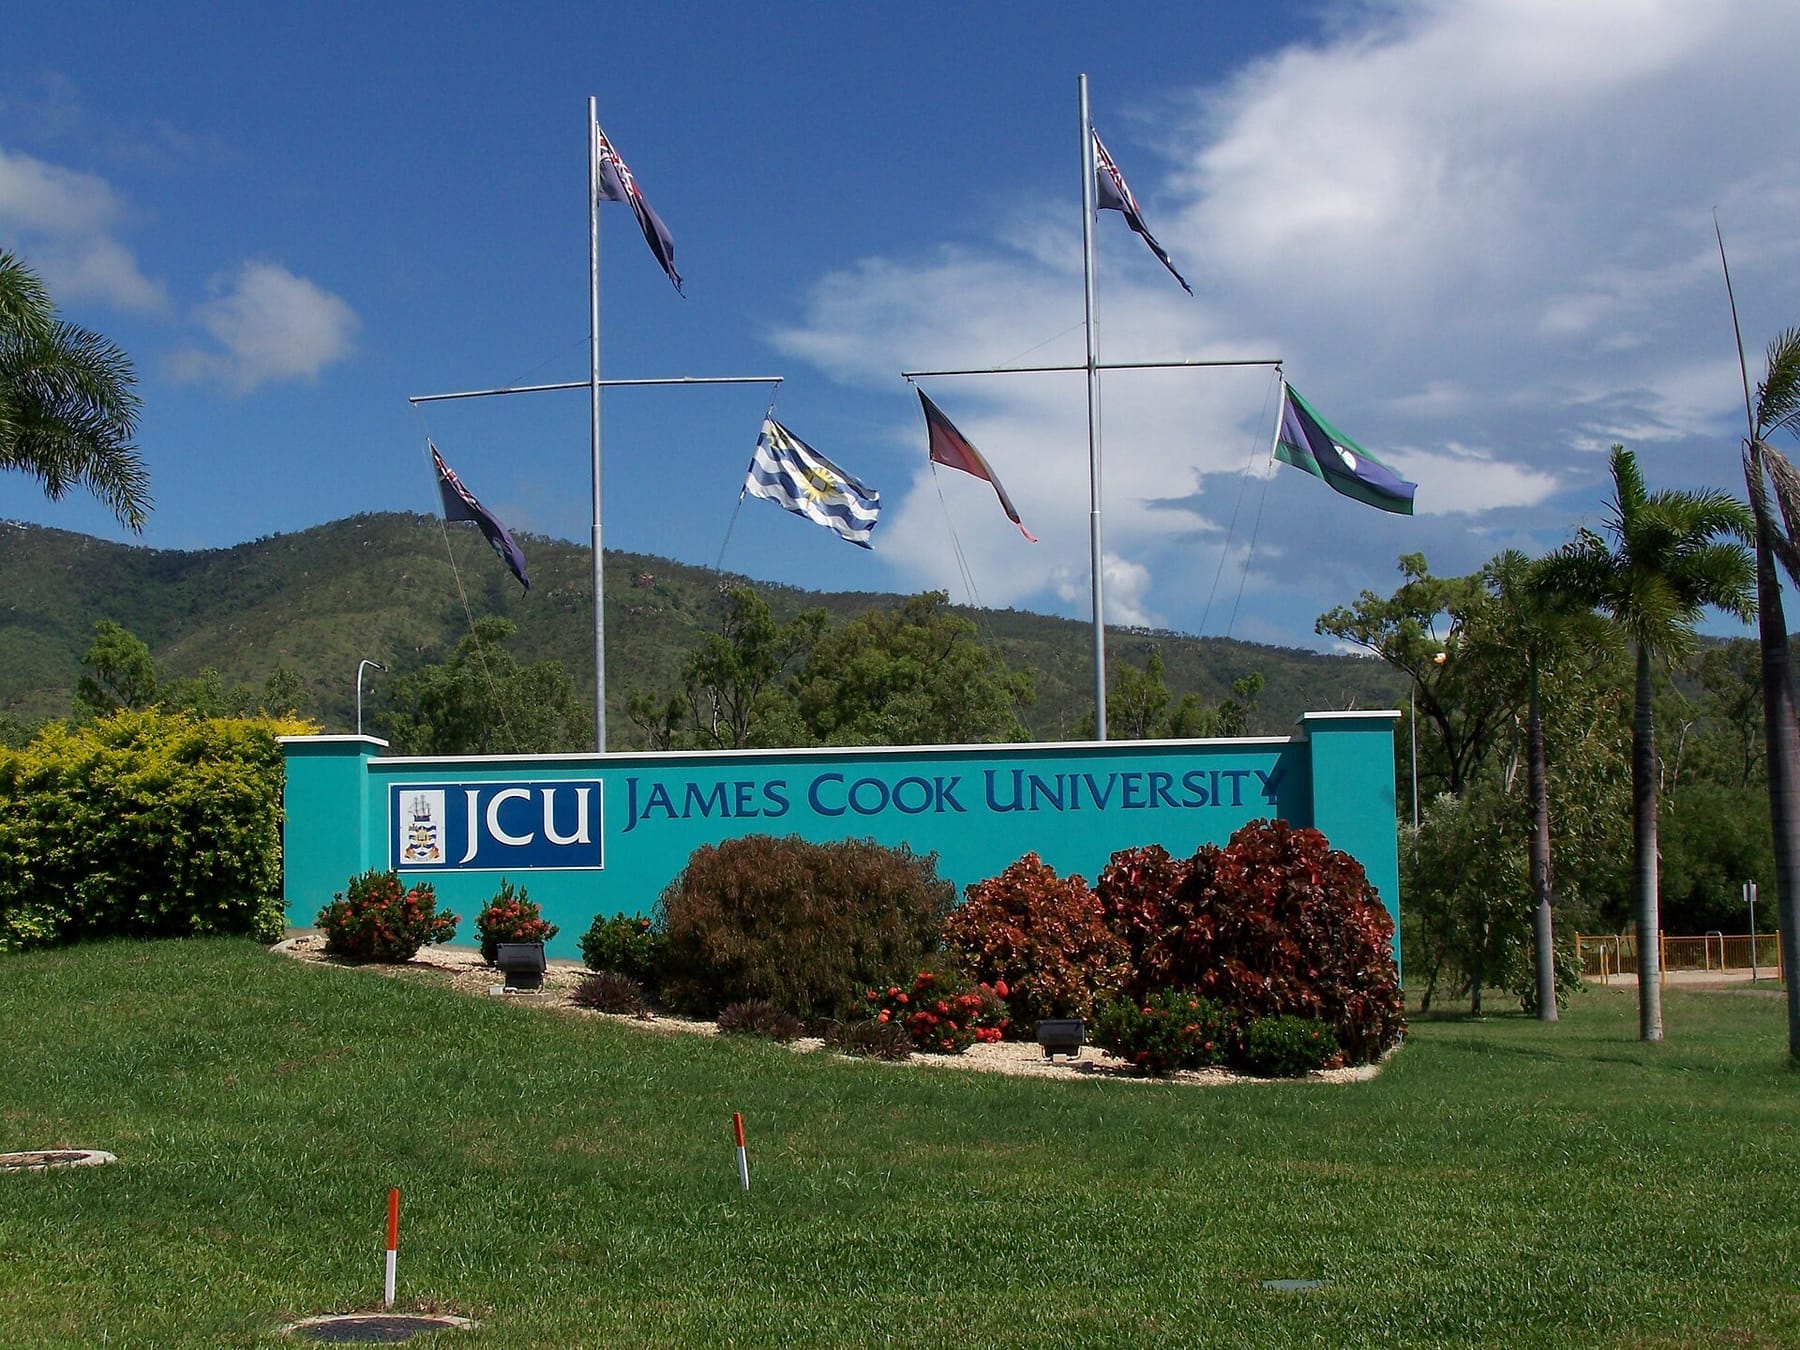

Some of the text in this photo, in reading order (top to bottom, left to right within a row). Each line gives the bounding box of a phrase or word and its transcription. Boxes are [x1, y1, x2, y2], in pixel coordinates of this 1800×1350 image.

[459, 788, 592, 864] JCU
[622, 769, 1285, 833] JAMES COOK UNIVERSITY
